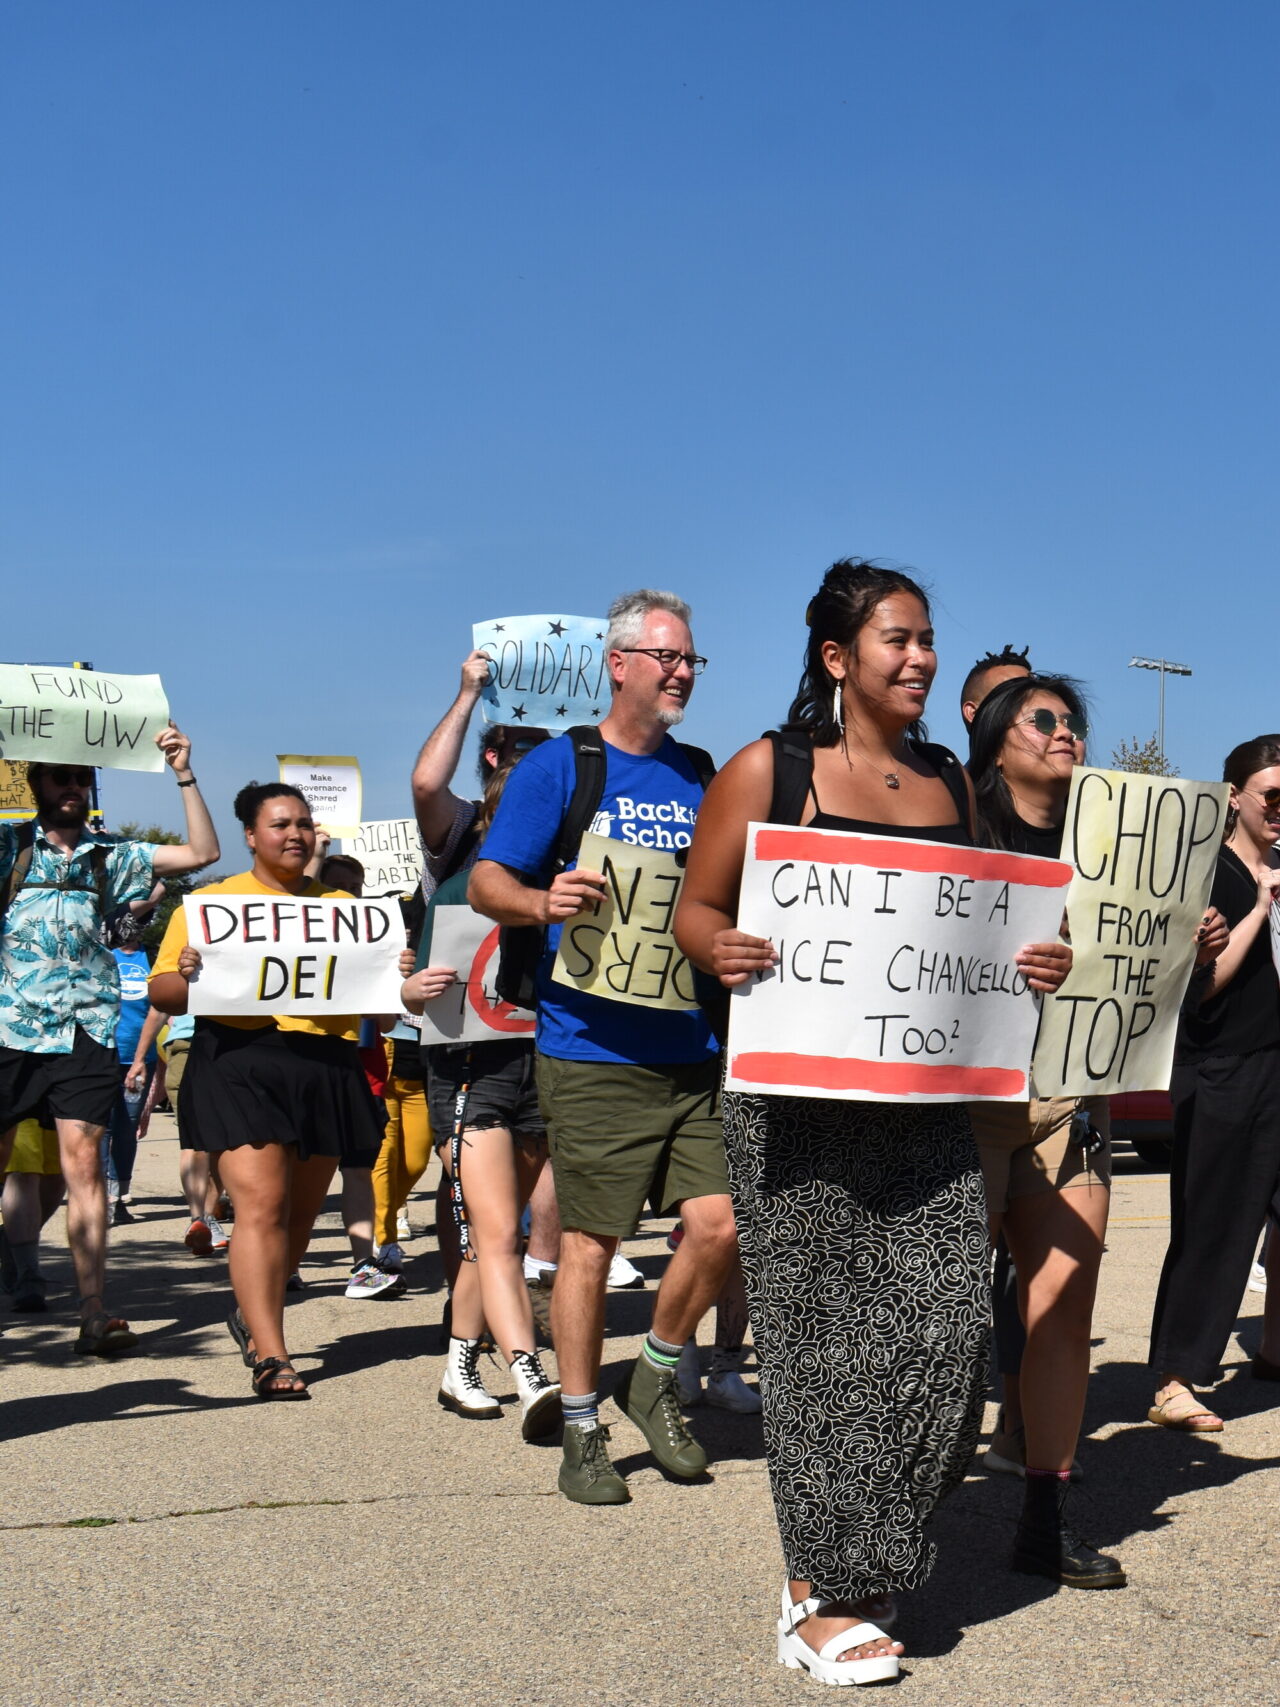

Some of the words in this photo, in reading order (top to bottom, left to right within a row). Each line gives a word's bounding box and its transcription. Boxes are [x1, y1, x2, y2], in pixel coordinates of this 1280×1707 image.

[31, 673, 123, 704] FUND
[0, 706, 54, 739] THE
[85, 708, 148, 750] UW
[297, 783, 348, 793] Governance
[310, 774, 333, 782] Make
[307, 794, 338, 802] Shared
[616, 796, 690, 824] Back
[689, 807, 698, 825] t
[621, 822, 692, 849] Scho
[1073, 773, 1220, 904] CHOP
[394, 853, 417, 864] THE
[593, 854, 681, 935] EN
[772, 863, 852, 908] CAN
[874, 870, 902, 914] I
[935, 875, 975, 918] BE
[988, 880, 1010, 926] A
[199, 902, 390, 945] DEFEND
[1097, 902, 1171, 948] FROM
[257, 954, 338, 1001] DEI
[1103, 954, 1160, 996] THE
[1055, 995, 1156, 1086] TOP
[455, 1095, 466, 1116] UWO
[454, 1181, 462, 1202] UWO
[460, 1224, 468, 1245] UWO
